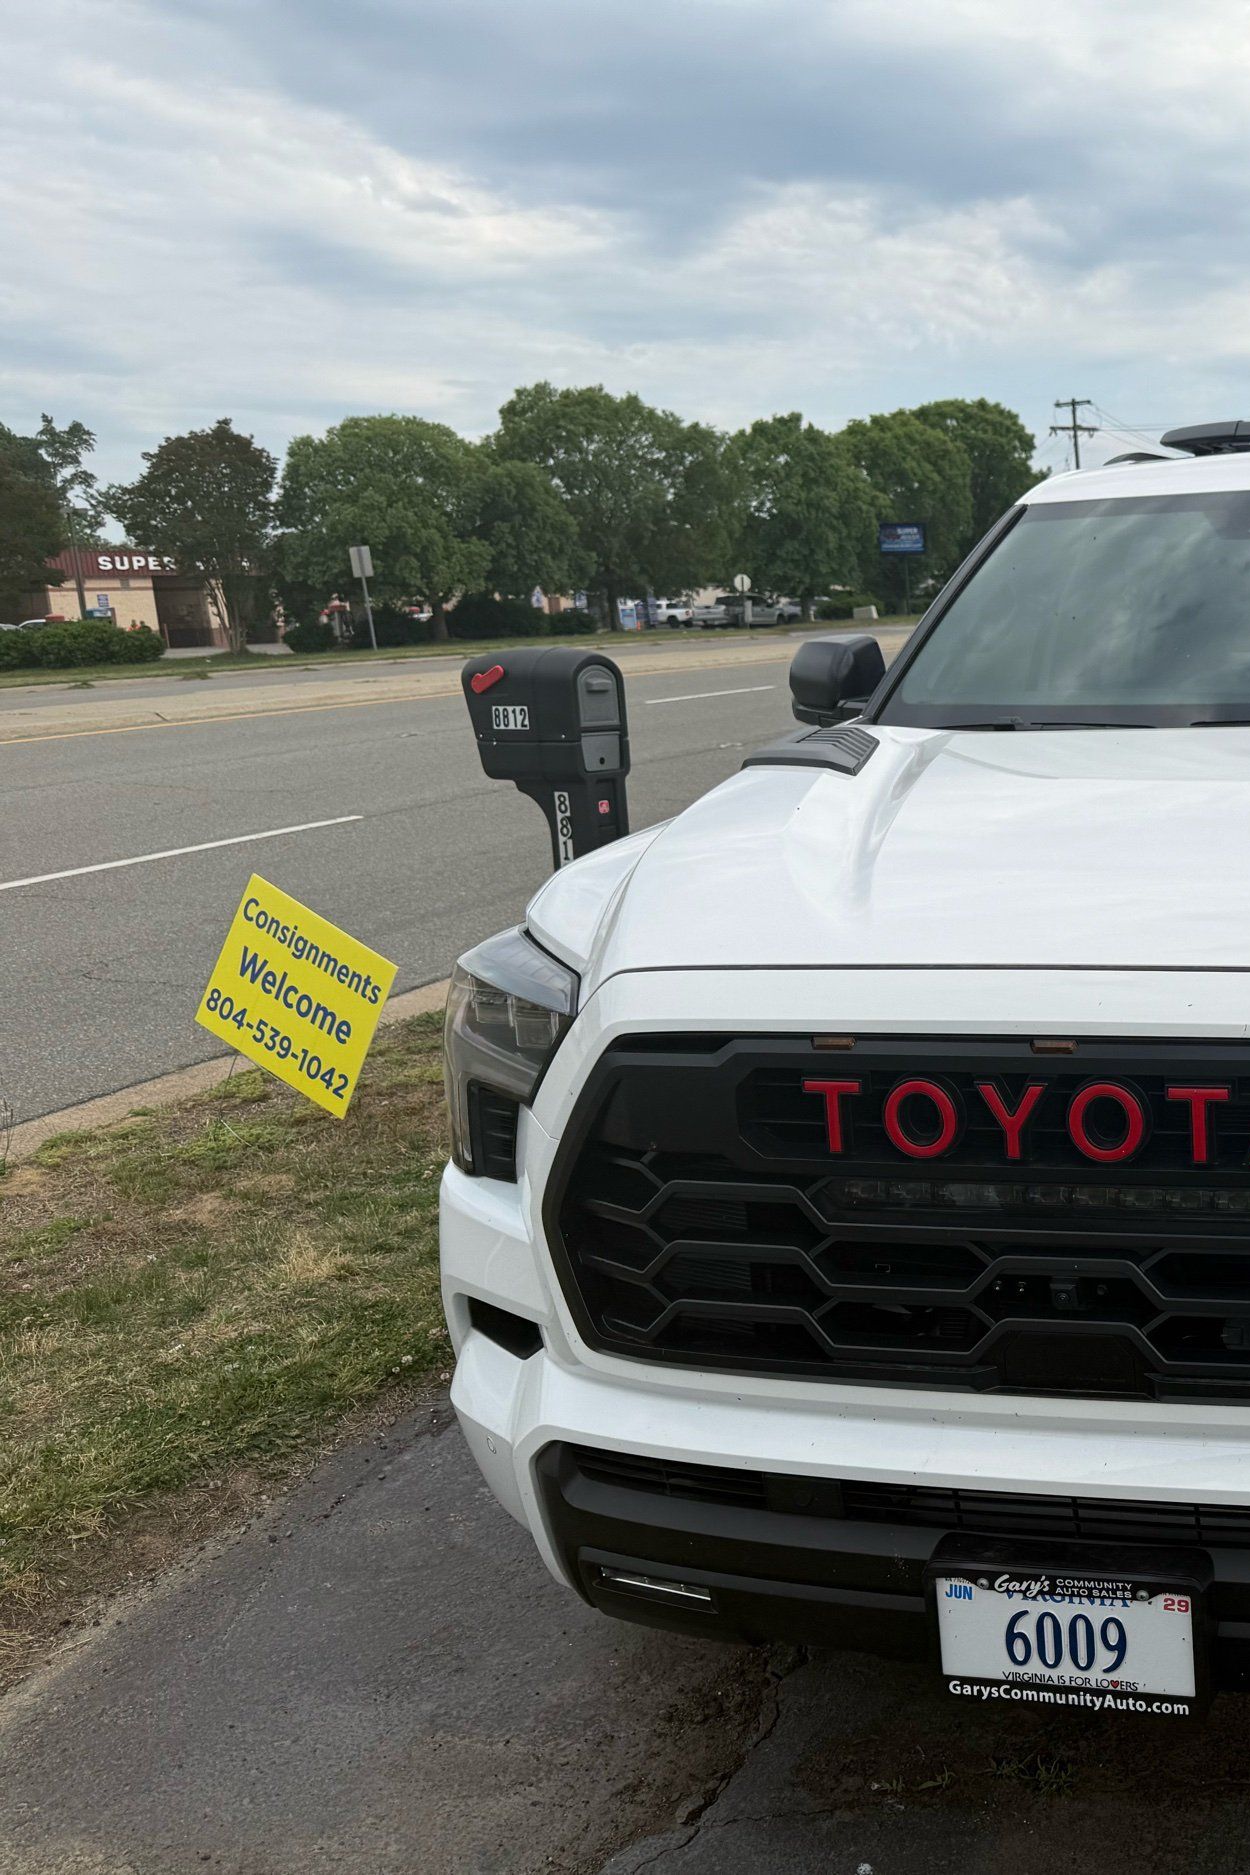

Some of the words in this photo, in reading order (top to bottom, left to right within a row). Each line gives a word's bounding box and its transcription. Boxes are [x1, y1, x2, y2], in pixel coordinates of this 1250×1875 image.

[493, 707, 529, 728] 8812
[242, 897, 383, 1005] Consignments
[238, 945, 352, 1045] Welcome
[205, 987, 349, 1100] 804-539-1042
[944, 1583, 974, 1601] JUN
[994, 1574, 1050, 1598] Gary's
[1055, 1578, 1133, 1590] COMMUNITY
[1055, 1587, 1088, 1596] AUTO
[1092, 1589, 1133, 1599] SALES
[1163, 1597, 1190, 1613] 29
[1005, 1609, 1128, 1674] 6009
[1002, 1670, 1055, 1685] VIRGINIA
[1057, 1674, 1067, 1685] IS
[1069, 1676, 1093, 1687] FOR
[948, 1679, 1190, 1716] GarysCommunityAuto.com
